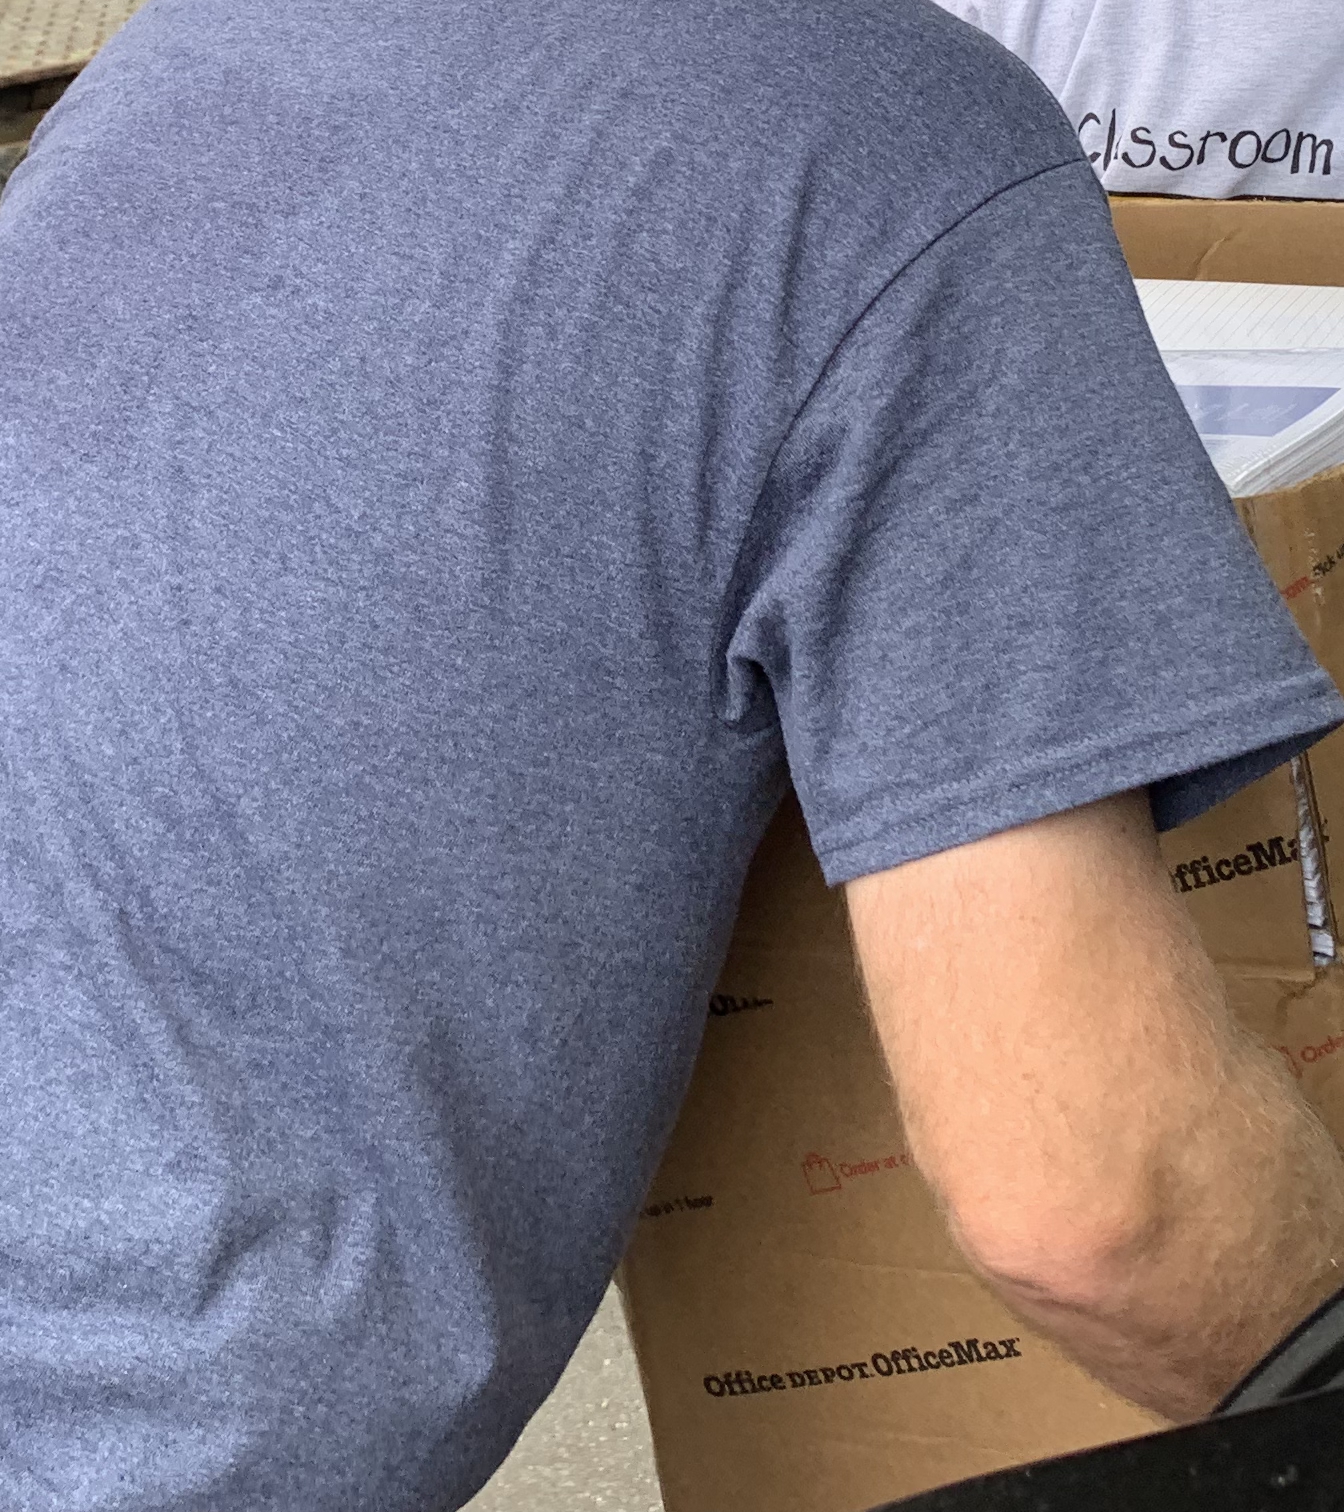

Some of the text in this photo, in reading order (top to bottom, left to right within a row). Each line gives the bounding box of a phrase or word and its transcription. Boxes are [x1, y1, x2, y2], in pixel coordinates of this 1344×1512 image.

[1077, 108, 1334, 176] Clssroom
[1169, 833, 1306, 893] fficeMa
[703, 1338, 1022, 1397] Office DEPOT OfficeMax
